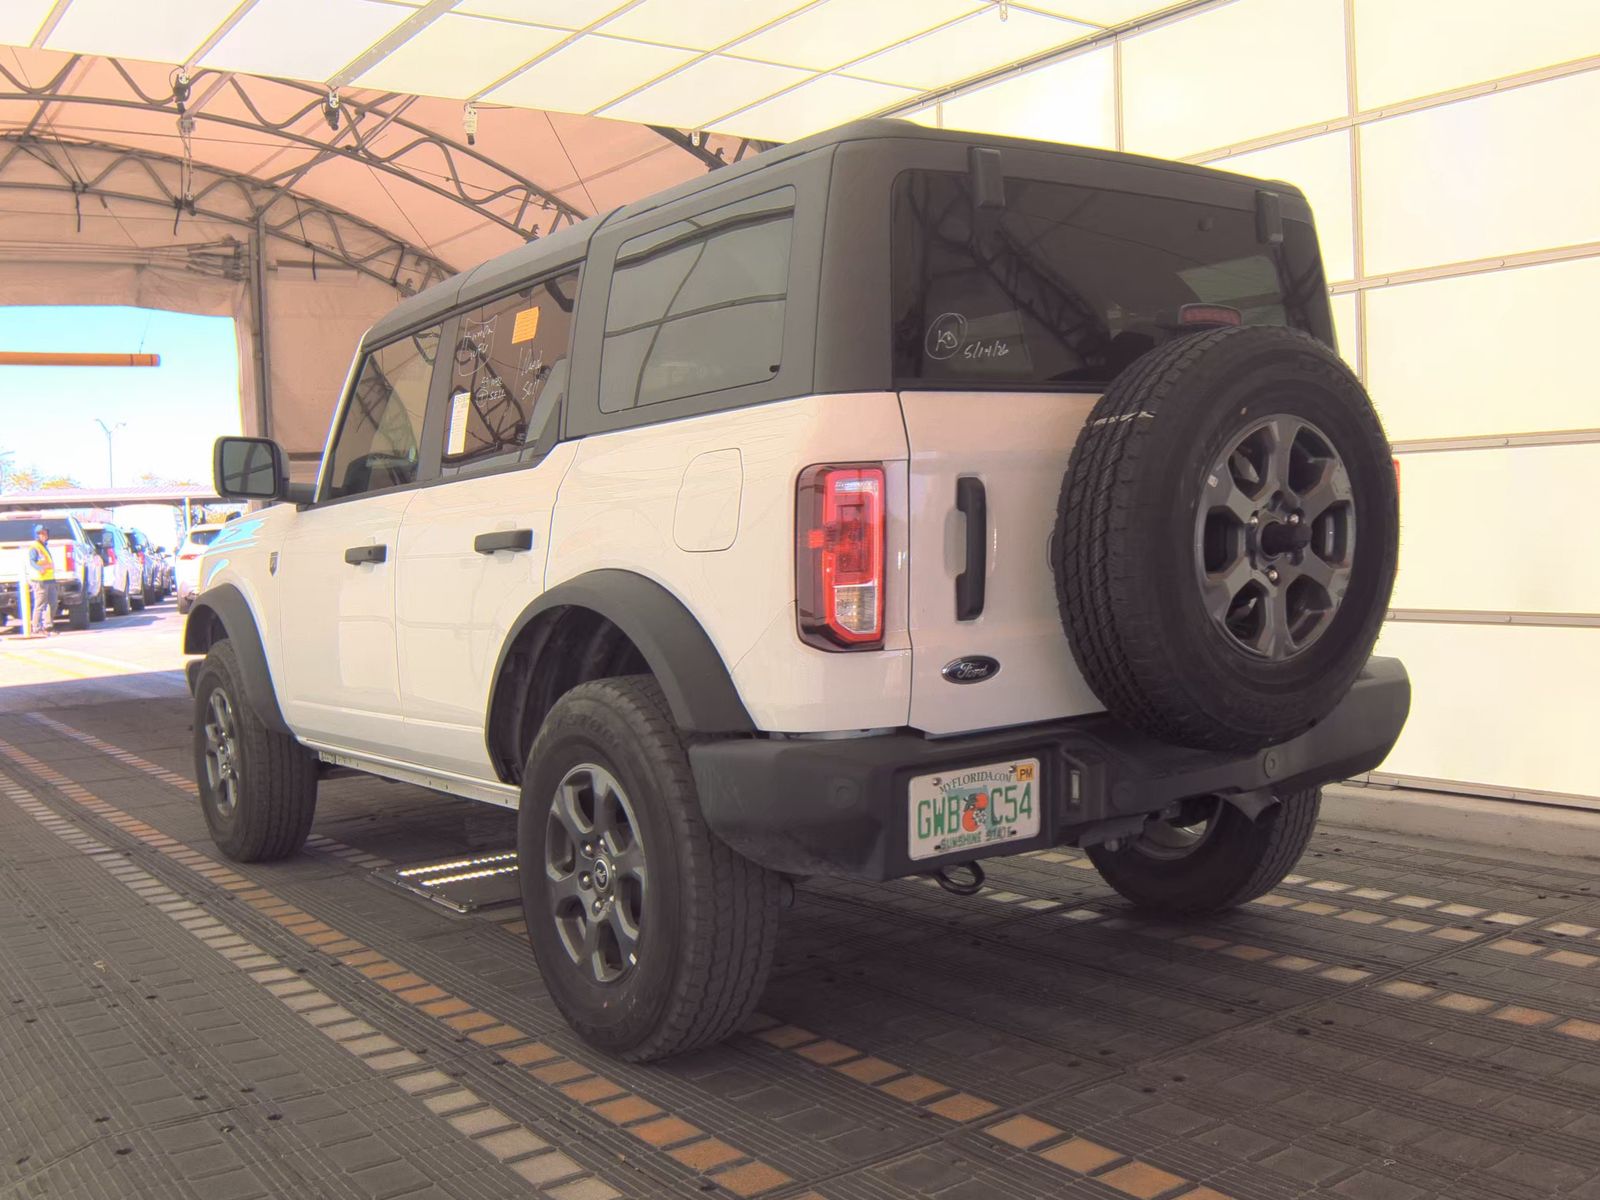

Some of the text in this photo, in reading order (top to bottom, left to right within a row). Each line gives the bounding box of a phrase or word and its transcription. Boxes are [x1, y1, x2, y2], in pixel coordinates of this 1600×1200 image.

[956, 662, 988, 679] Ford
[938, 771, 1013, 794] MYFLORIDA.COM
[1019, 767, 1034, 779] PM
[917, 782, 1033, 840] GWB C54
